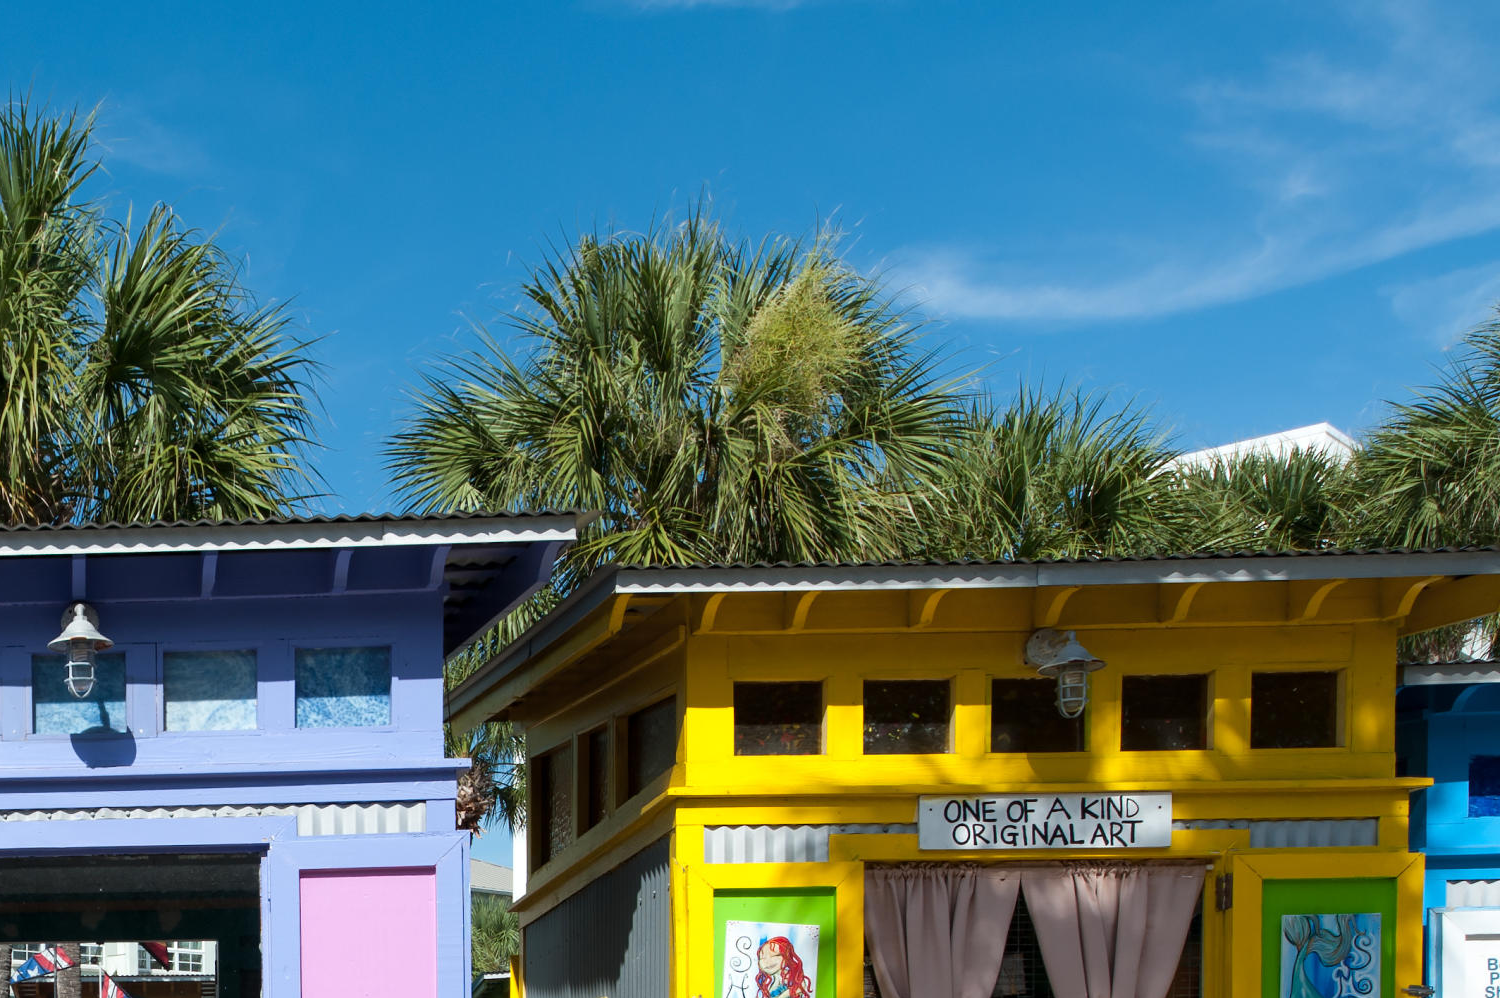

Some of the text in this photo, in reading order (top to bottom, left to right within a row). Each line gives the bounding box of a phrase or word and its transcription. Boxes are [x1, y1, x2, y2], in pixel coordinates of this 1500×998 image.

[944, 796, 1140, 823] ONE OF A KIND
[952, 820, 1143, 847] ORIGINAL ART
[1487, 957, 1500, 971] B
